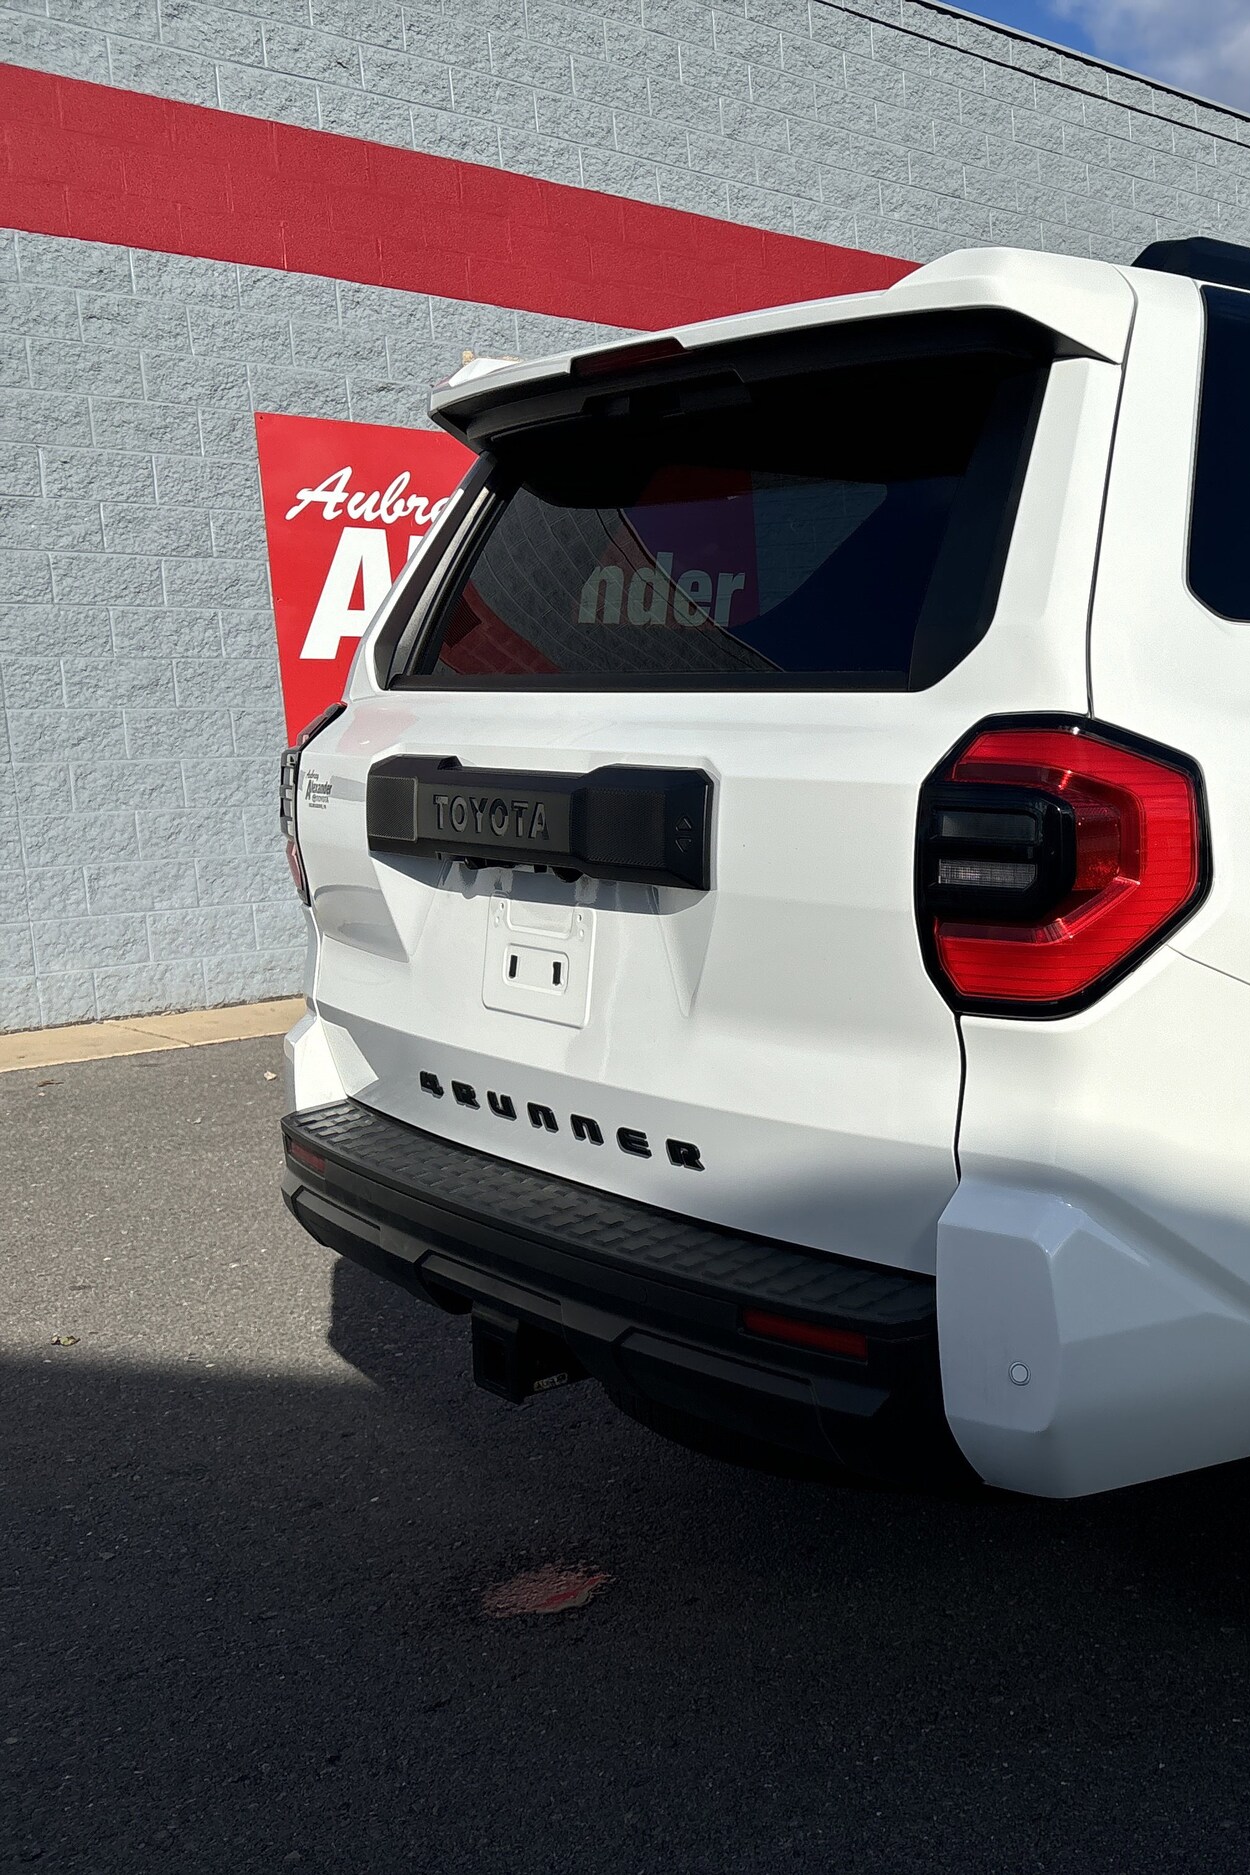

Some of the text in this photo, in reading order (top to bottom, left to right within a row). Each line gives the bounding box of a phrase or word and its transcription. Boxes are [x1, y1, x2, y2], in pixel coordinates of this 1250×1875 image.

[299, 527, 424, 660] A
[433, 794, 550, 840] TOYOTA
[419, 1070, 705, 1171] 4RUNNER
